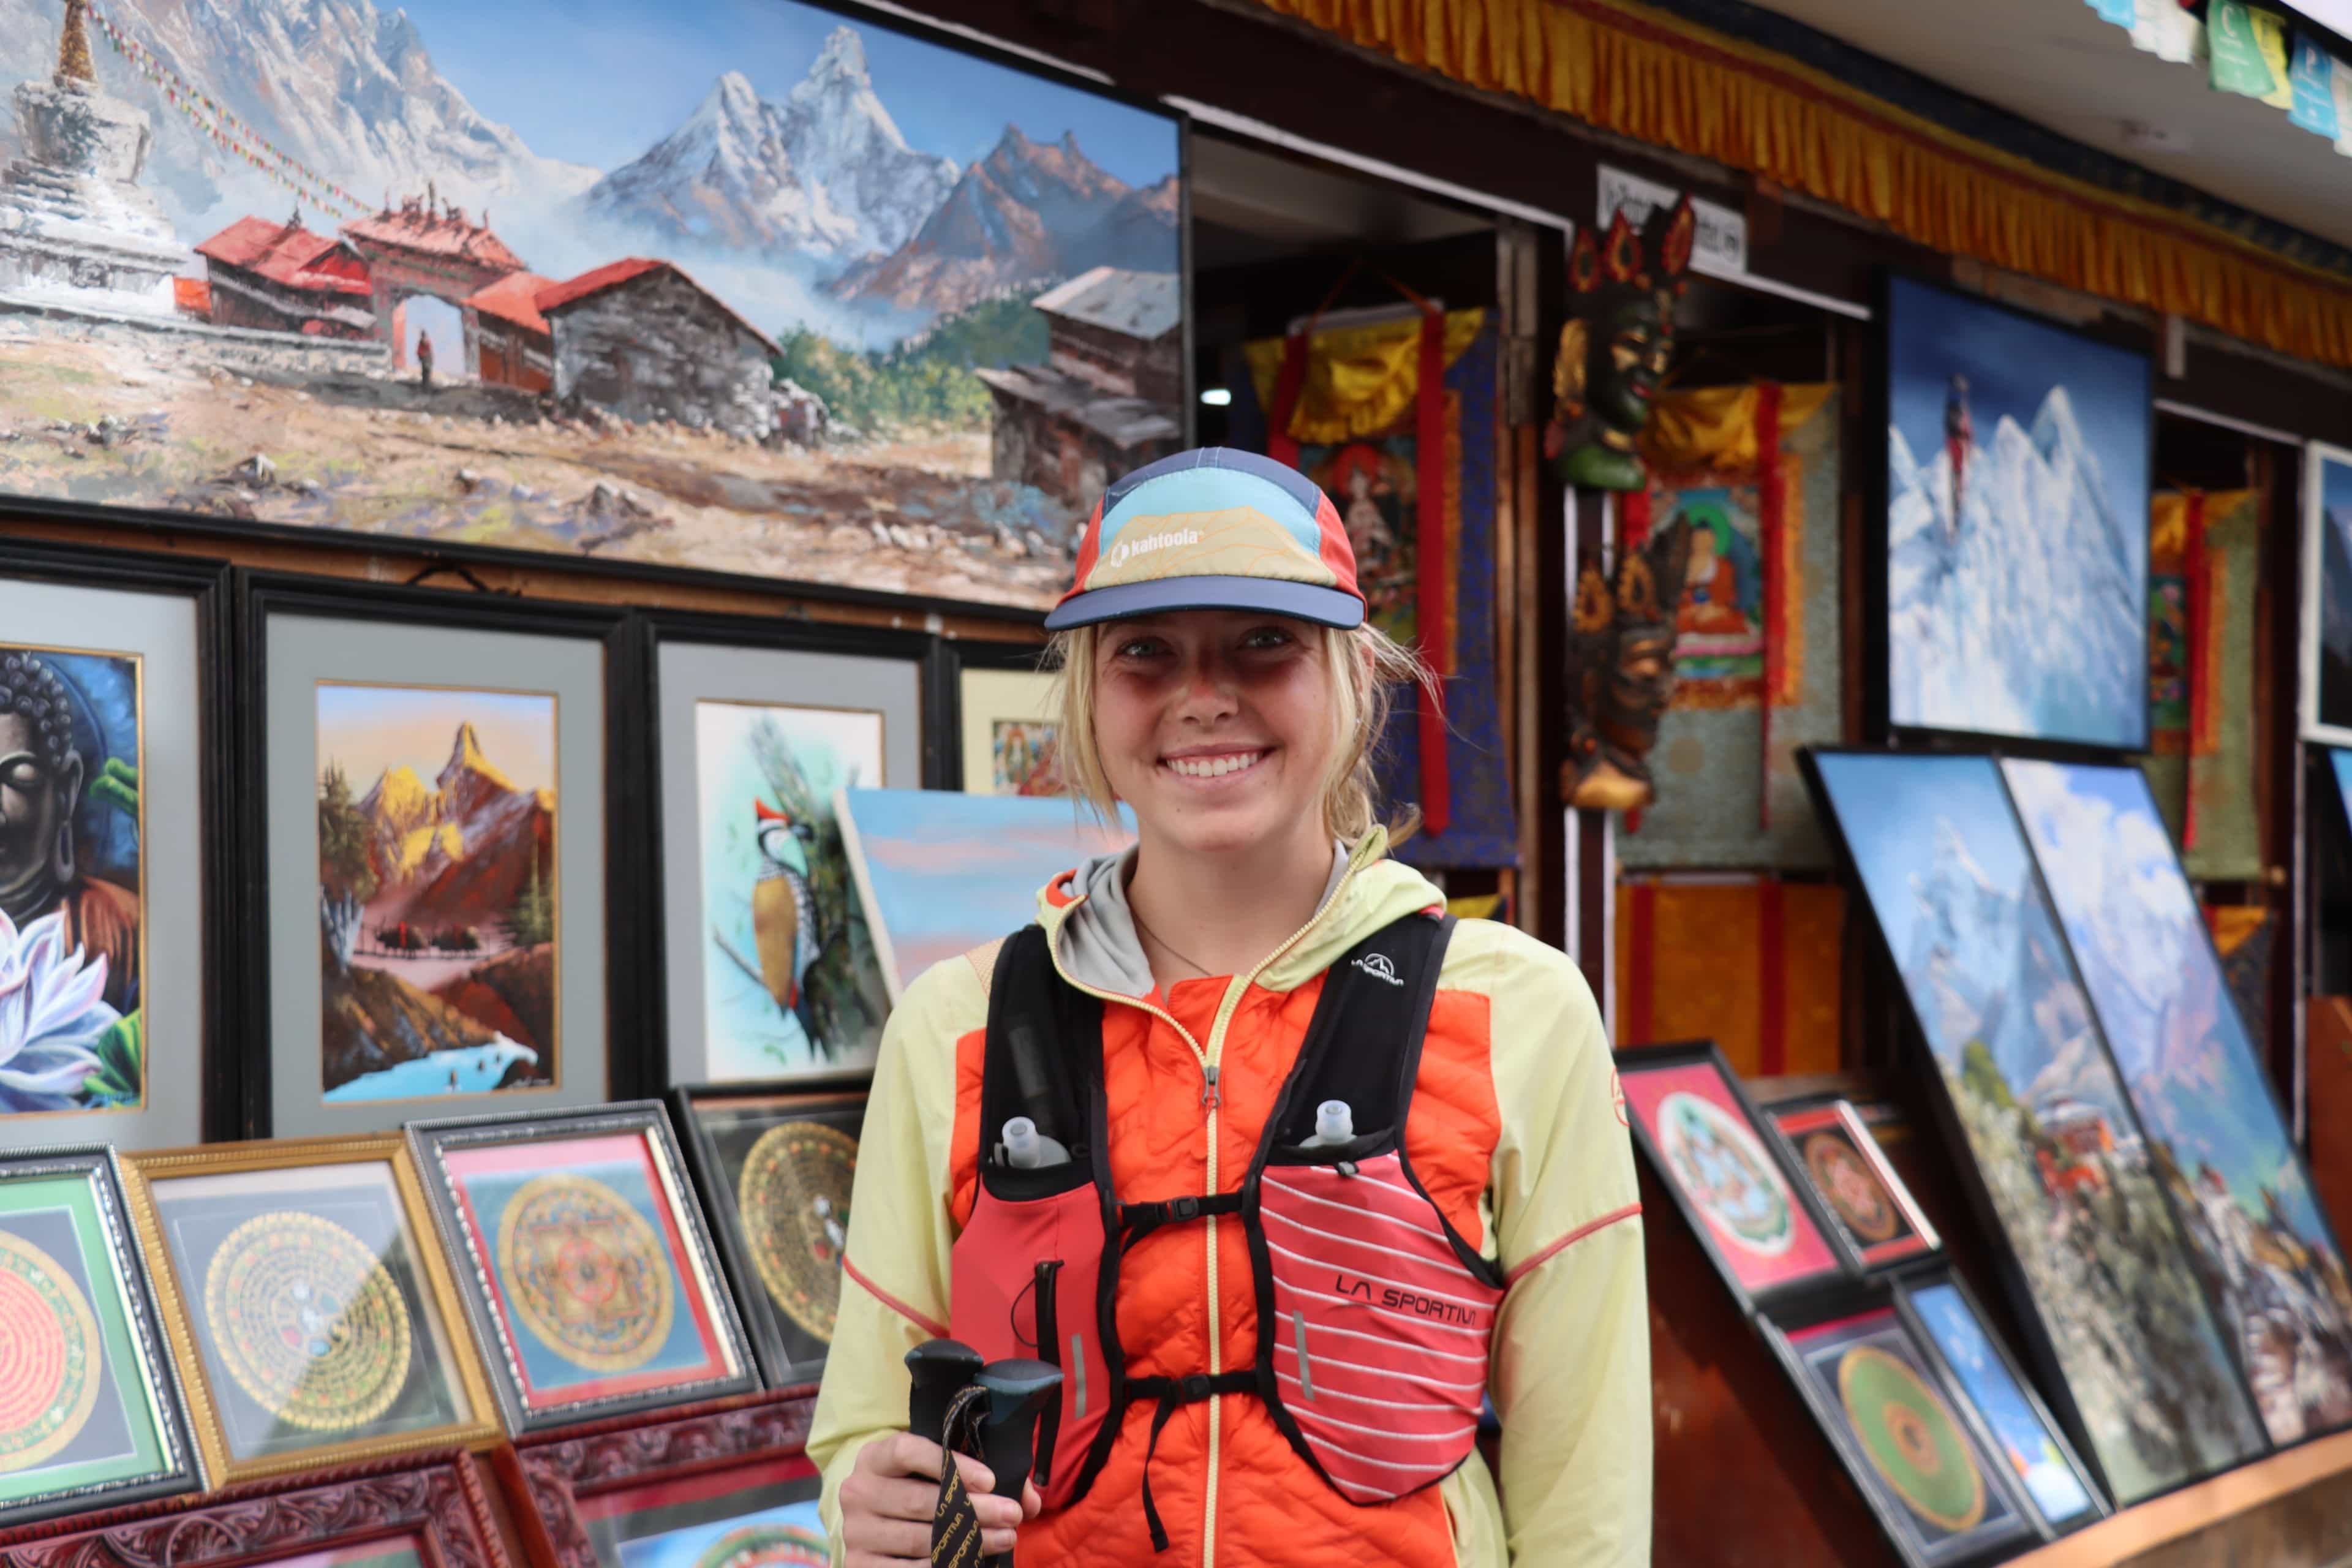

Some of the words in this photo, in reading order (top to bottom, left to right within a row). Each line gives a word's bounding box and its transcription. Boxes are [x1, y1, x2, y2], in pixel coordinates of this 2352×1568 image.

[1132, 528, 1197, 557] kahtoola
[1336, 1275, 1371, 1300] LA
[931, 1512, 964, 1564] SPORTIVA
